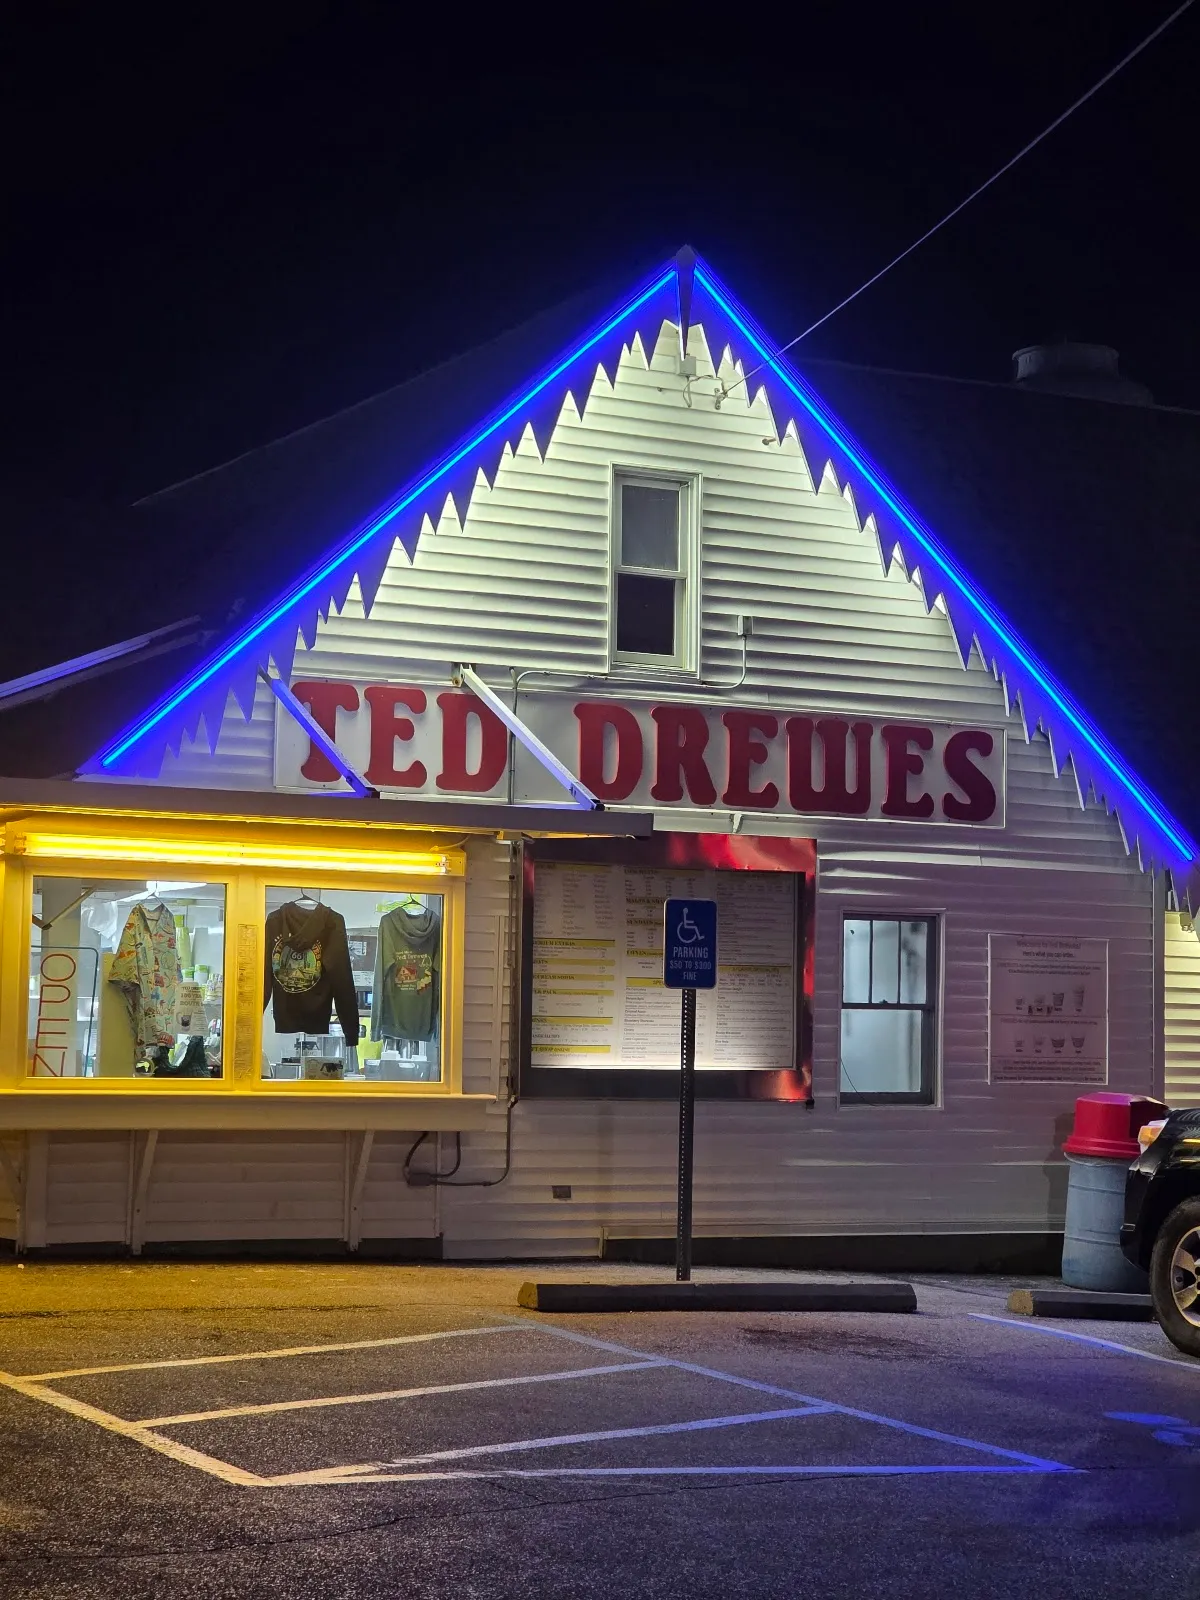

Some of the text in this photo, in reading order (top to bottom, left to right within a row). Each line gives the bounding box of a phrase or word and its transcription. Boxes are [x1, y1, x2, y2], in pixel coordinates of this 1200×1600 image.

[291, 681, 998, 823] TED DREWES
[291, 951, 302, 960] 66
[673, 946, 709, 959] PARKING
[669, 960, 712, 970] $50 TO $300
[683, 971, 697, 981] FINE
[31, 952, 77, 1078] OPEN
